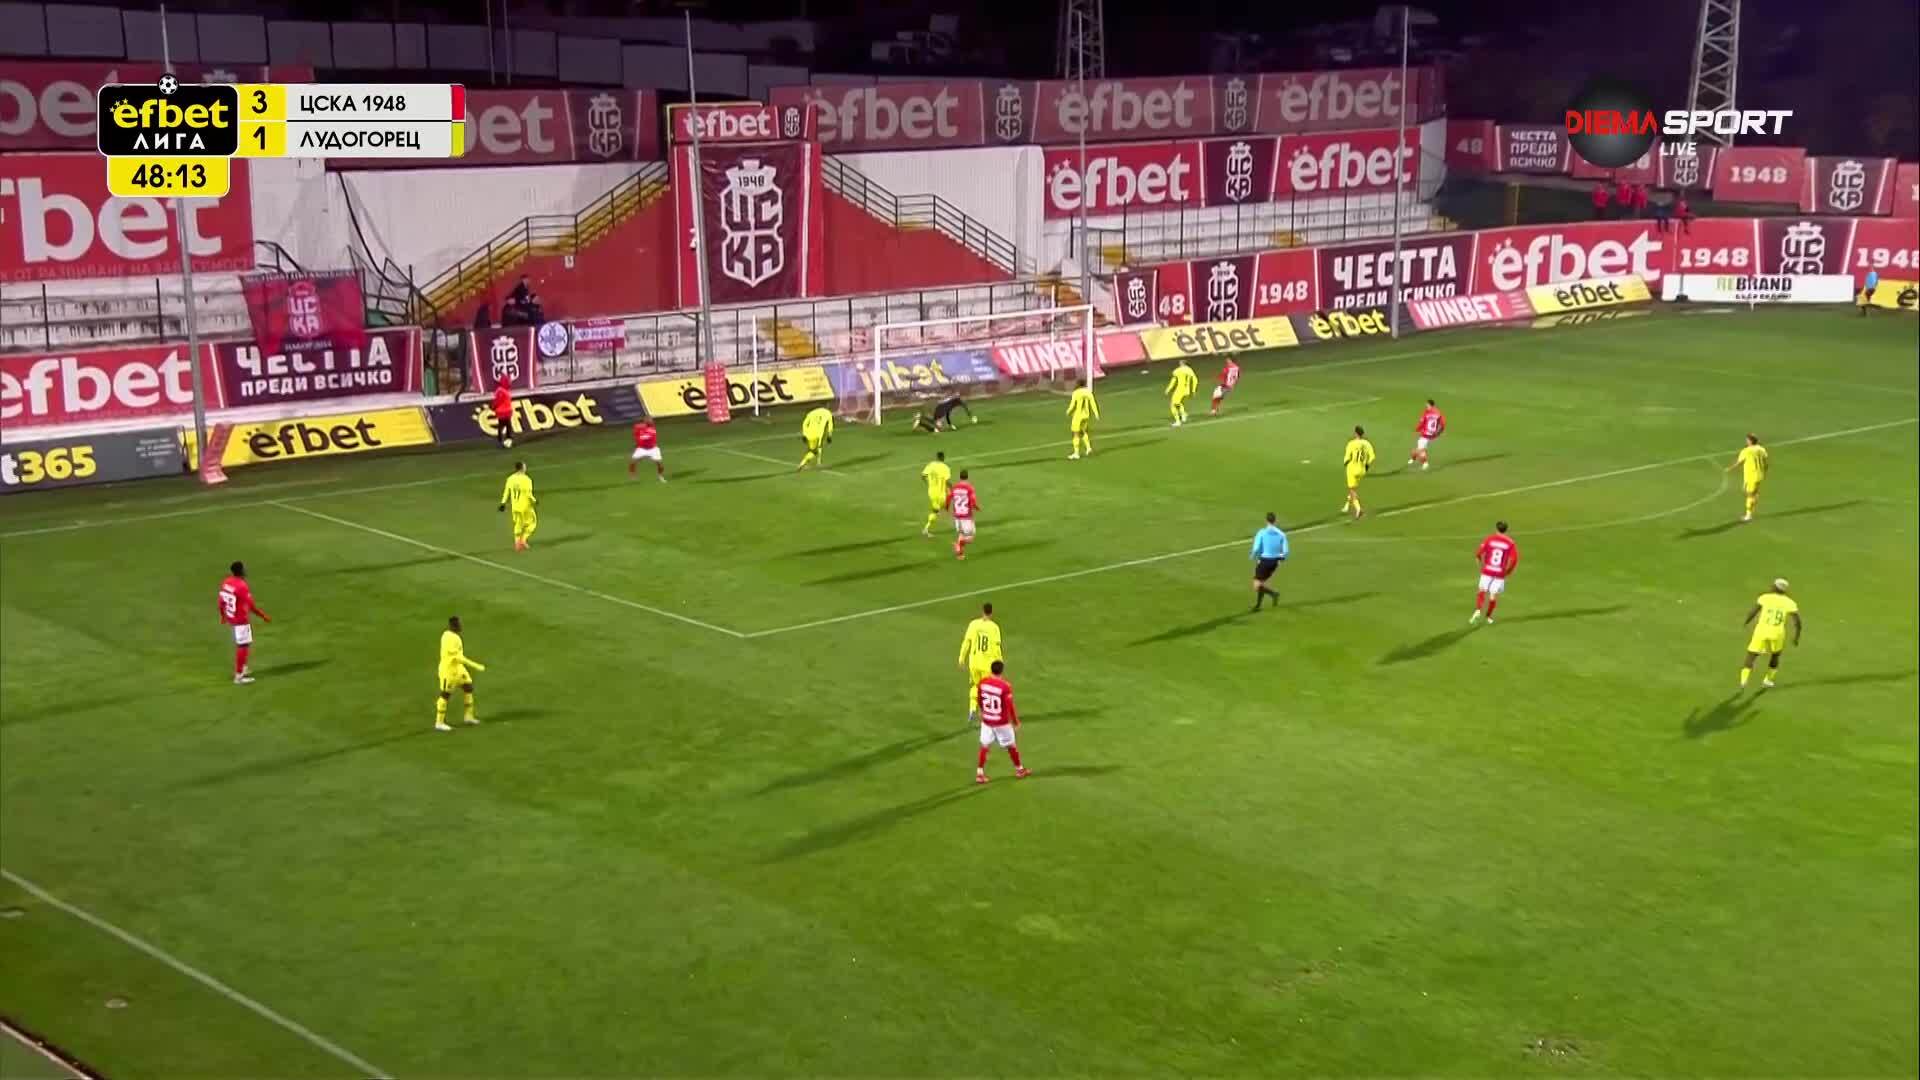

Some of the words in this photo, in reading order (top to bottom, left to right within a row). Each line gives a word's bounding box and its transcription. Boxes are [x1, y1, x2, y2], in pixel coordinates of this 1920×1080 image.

[1058, 80, 1195, 132] efbet
[1280, 72, 1400, 122] efbet
[686, 110, 771, 137] efbet
[1511, 142, 1558, 156] ПРЕДИ
[738, 176, 765, 187] 1948
[1290, 142, 1414, 192] efbet
[1730, 166, 1788, 183] 1948
[1051, 153, 1191, 211] efbet
[1333, 245, 1457, 290] ЧЕСТТА
[1491, 231, 1664, 292] efbet
[1680, 248, 1749, 268] 1948
[1260, 280, 1309, 305] 1948
[1556, 281, 1625, 307] efbet
[1311, 309, 1391, 339] efbet
[1414, 294, 1500, 327] WINBET
[1175, 323, 1266, 354] efbet
[241, 376, 308, 397] ПРЕДИ
[315, 369, 393, 391] ВСИЧКО
[683, 374, 793, 410] ebet
[249, 418, 382, 459] efbet
[1, 446, 97, 485] t365
[952, 495, 969, 515] 22
[1489, 548, 1504, 566] 8
[976, 633, 989, 653] 18
[981, 692, 1003, 715] 20
